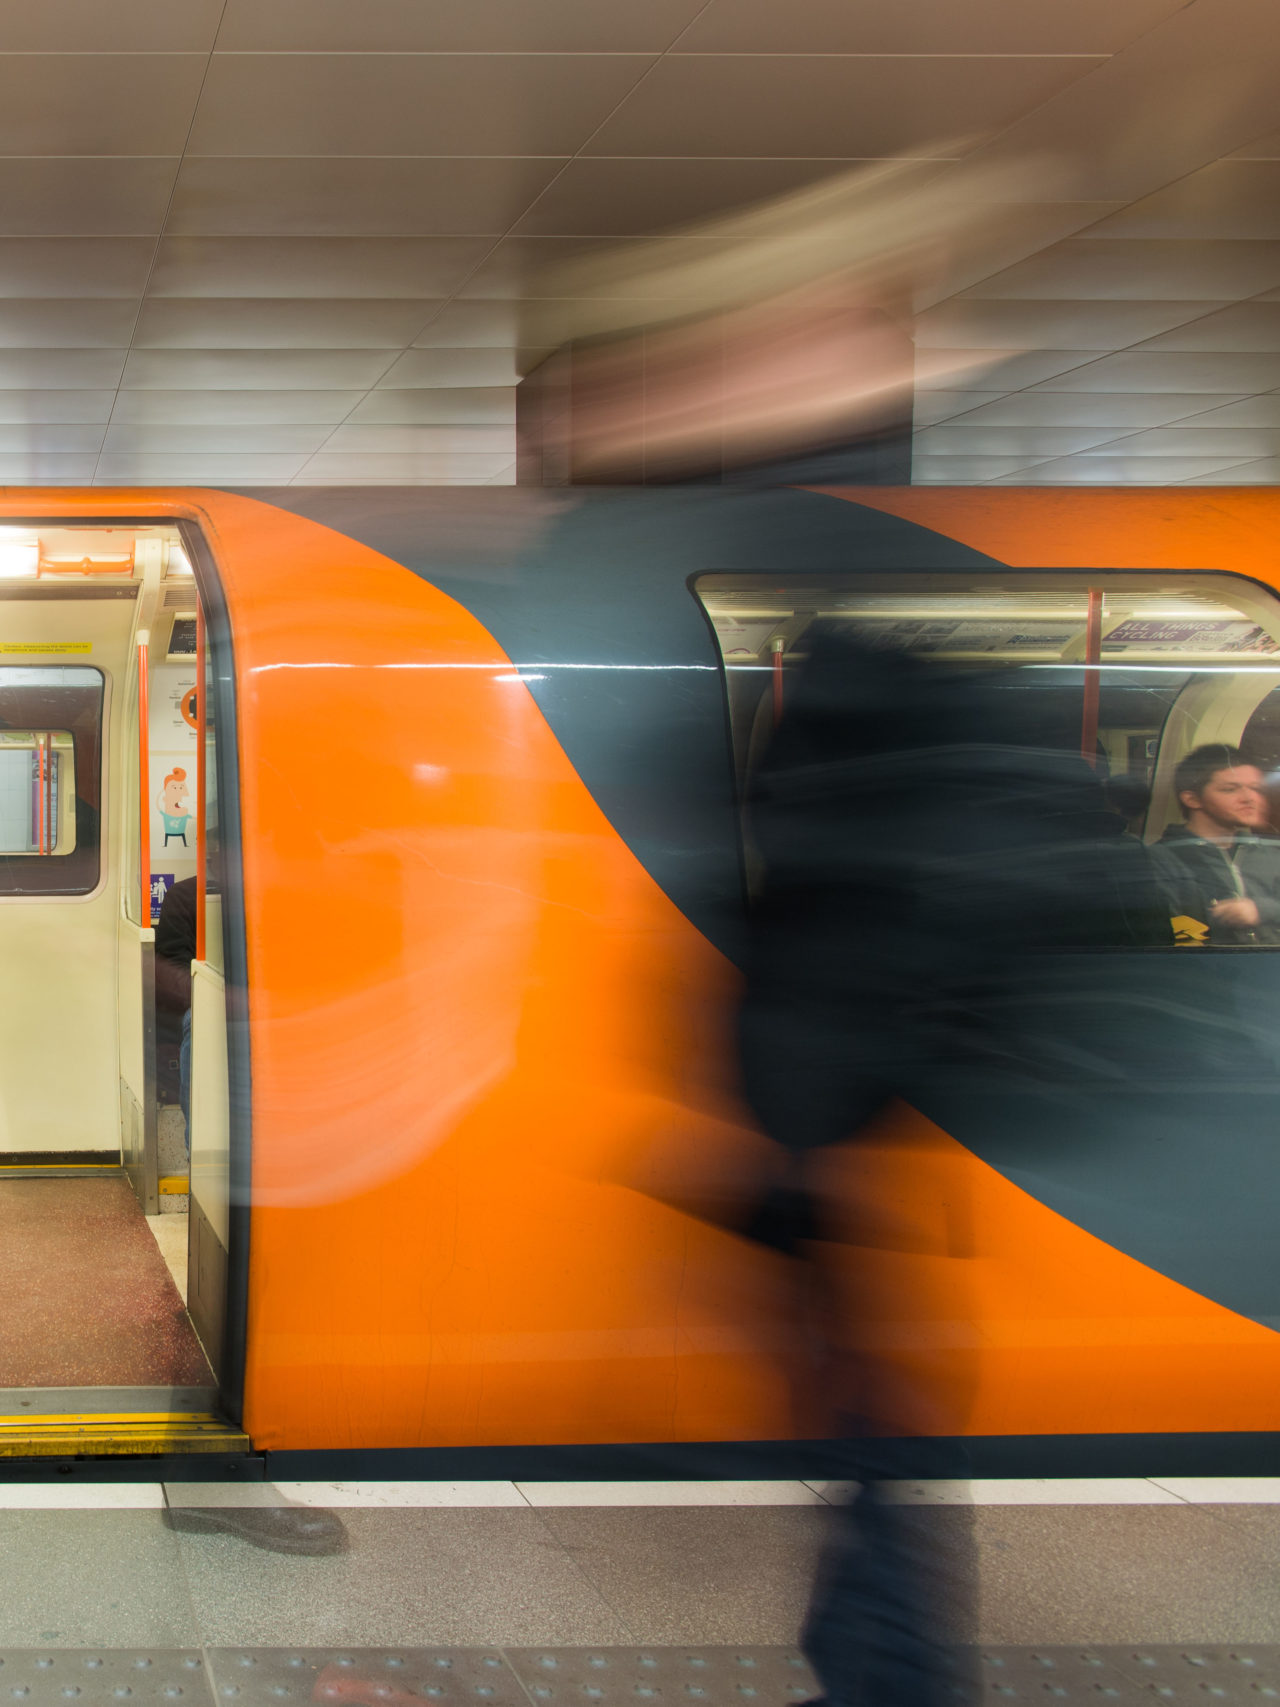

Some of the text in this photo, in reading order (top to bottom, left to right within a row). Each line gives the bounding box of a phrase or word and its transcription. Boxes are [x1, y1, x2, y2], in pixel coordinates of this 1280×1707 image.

[1119, 622, 1218, 631] ALL THINGS
[1109, 631, 1177, 640] CYCLING
